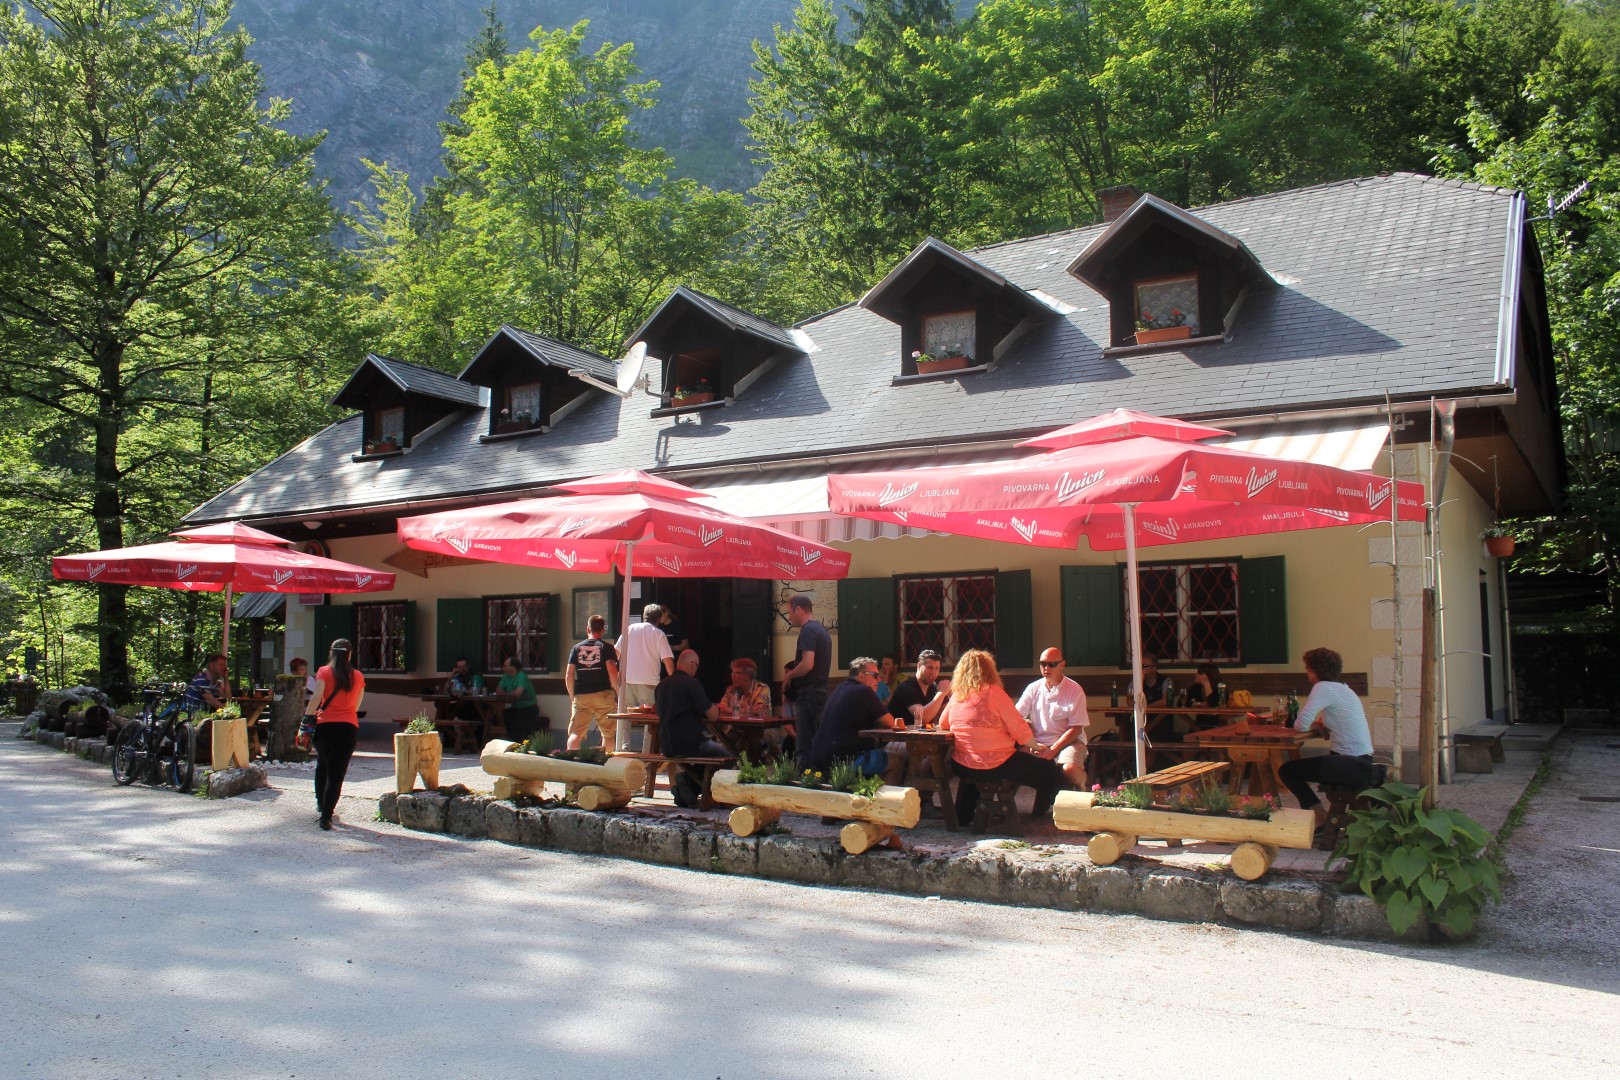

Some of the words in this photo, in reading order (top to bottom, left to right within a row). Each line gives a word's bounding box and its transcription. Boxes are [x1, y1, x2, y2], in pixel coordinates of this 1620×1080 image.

[1003, 483, 1050, 493] PIVOVARNA
[1054, 469, 1105, 503] Union
[1106, 474, 1160, 487] LJUBLJANA
[1209, 474, 1243, 484] PIVOVARNA
[1245, 466, 1277, 499] Union
[1278, 480, 1308, 490] LJUBLJANA
[878, 481, 919, 507] Union
[919, 488, 960, 498] LJUBLJANA
[1336, 486, 1364, 497] PIVOVARNA
[1365, 482, 1391, 511] Union
[667, 525, 697, 536] PIVOVARNA
[698, 523, 724, 547] Union
[725, 536, 752, 546] LJUBLJANA
[800, 546, 822, 566] Union
[86, 562, 106, 579] Union
[175, 563, 197, 580] Union
[272, 569, 294, 584] Union
[355, 573, 372, 588] Union
